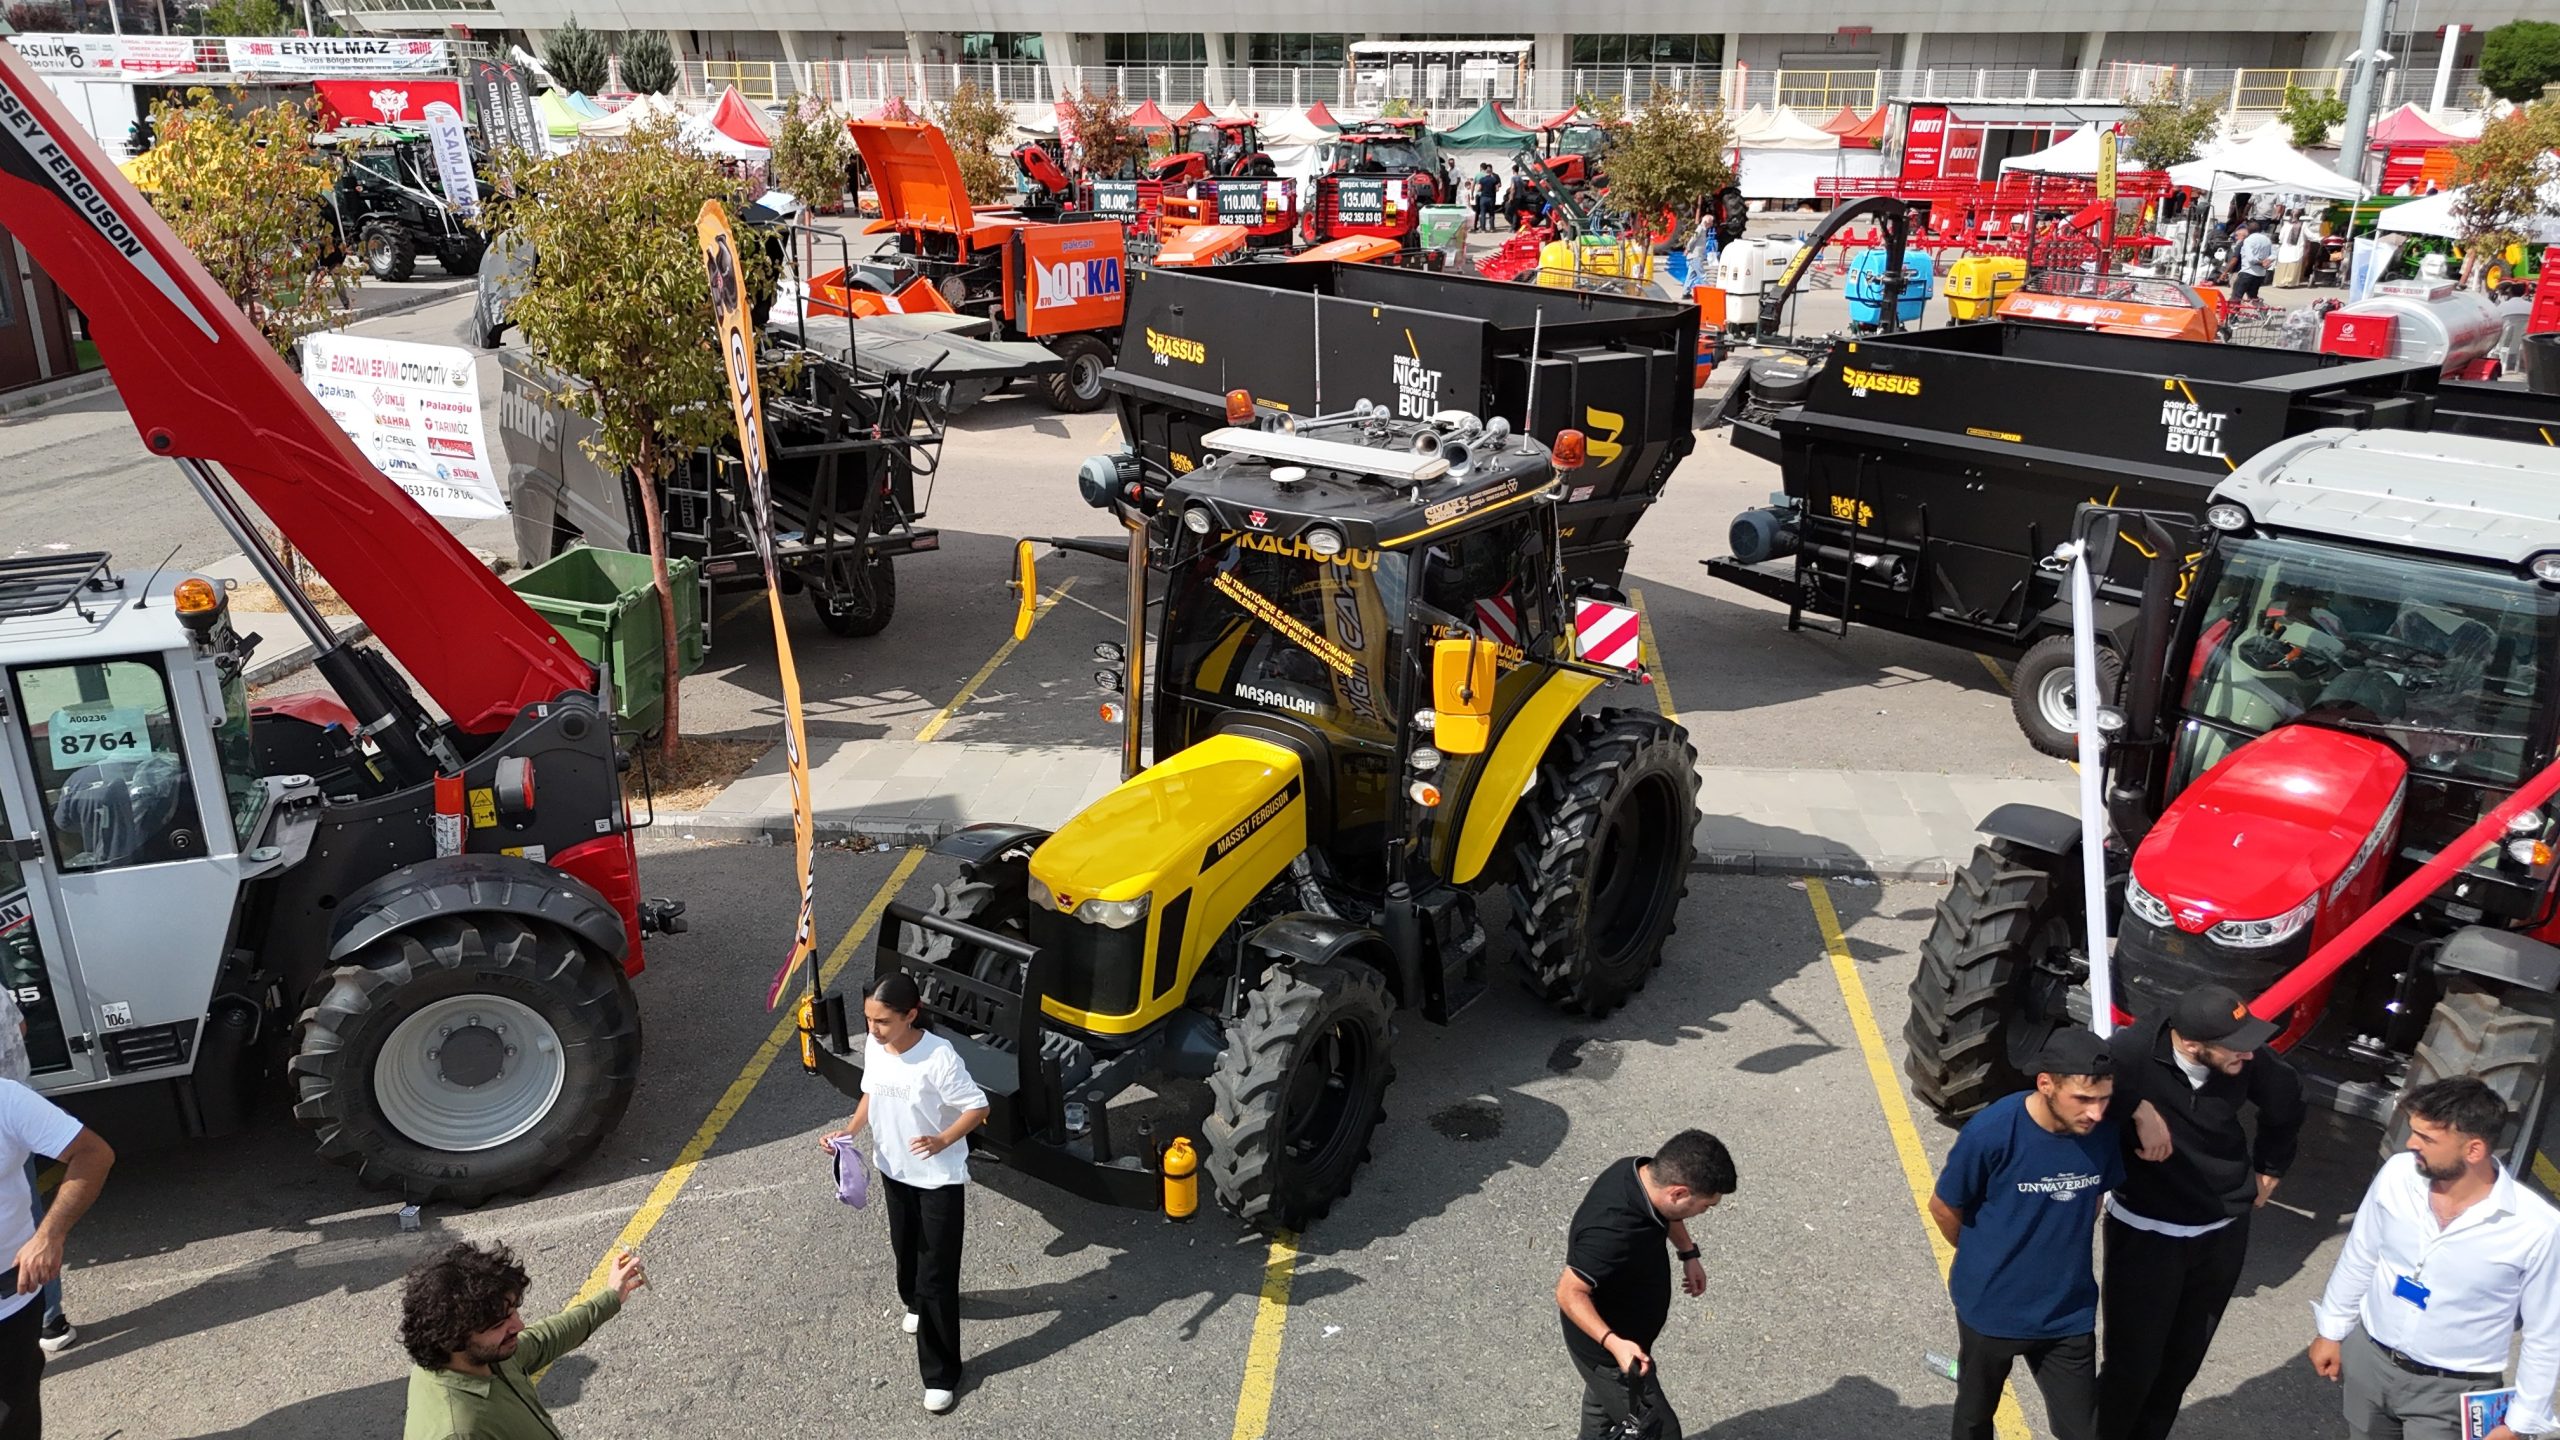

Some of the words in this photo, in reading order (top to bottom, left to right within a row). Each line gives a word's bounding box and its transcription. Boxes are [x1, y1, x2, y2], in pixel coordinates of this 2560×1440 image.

[38, 142, 143, 258] FERGUSON
[1219, 214, 1234, 224] 0542
[1235, 214, 1246, 224] 352
[1339, 212, 1353, 222] 0542
[1353, 212, 1365, 222] 352
[1052, 256, 1121, 301] ORKA
[2010, 298, 2122, 320] paksan
[1146, 326, 1205, 364] BRASSUS
[331, 354, 370, 377] BAYRAM
[371, 358, 399, 379] SEVİM
[400, 361, 448, 385] OTOMOTİV
[1393, 354, 1411, 366] DARK
[1411, 358, 1420, 368] AS
[1392, 363, 1442, 392] NIGHT
[1842, 366, 1921, 396] BRASSUS
[1399, 385, 1422, 397] STRONG
[1422, 390, 1430, 399] AS
[1430, 392, 1436, 400] A
[1398, 393, 1439, 422] BULL
[2163, 400, 2186, 410] DARK
[2186, 403, 2199, 411] AS
[381, 415, 411, 428] SAHRA
[2160, 407, 2227, 431] NIGHT
[2168, 425, 2197, 436] STRONG
[2165, 432, 2227, 459] BULL
[427, 487, 445, 498] 761
[447, 488, 459, 499] 78
[1213, 577, 1258, 614] DÜMENLEME
[1257, 608, 1288, 634] SİSTEMİ
[1220, 571, 1232, 584] BU
[1232, 578, 1277, 615] TRAKTÖRDE
[1276, 607, 1316, 639] E-SURVEY
[1314, 634, 1356, 667] OTOMATİK
[1235, 683, 1316, 715] MAŞAALLAH
[69, 714, 107, 724] A00236
[60, 731, 137, 755] 8764
[1216, 819, 1251, 856] MASSEY
[1251, 789, 1289, 830] FERGUSON
[104, 1013, 125, 1027] 106
[2017, 1174, 2101, 1193] UNWAVERING
[2471, 1405, 2483, 1438] ATLAS
